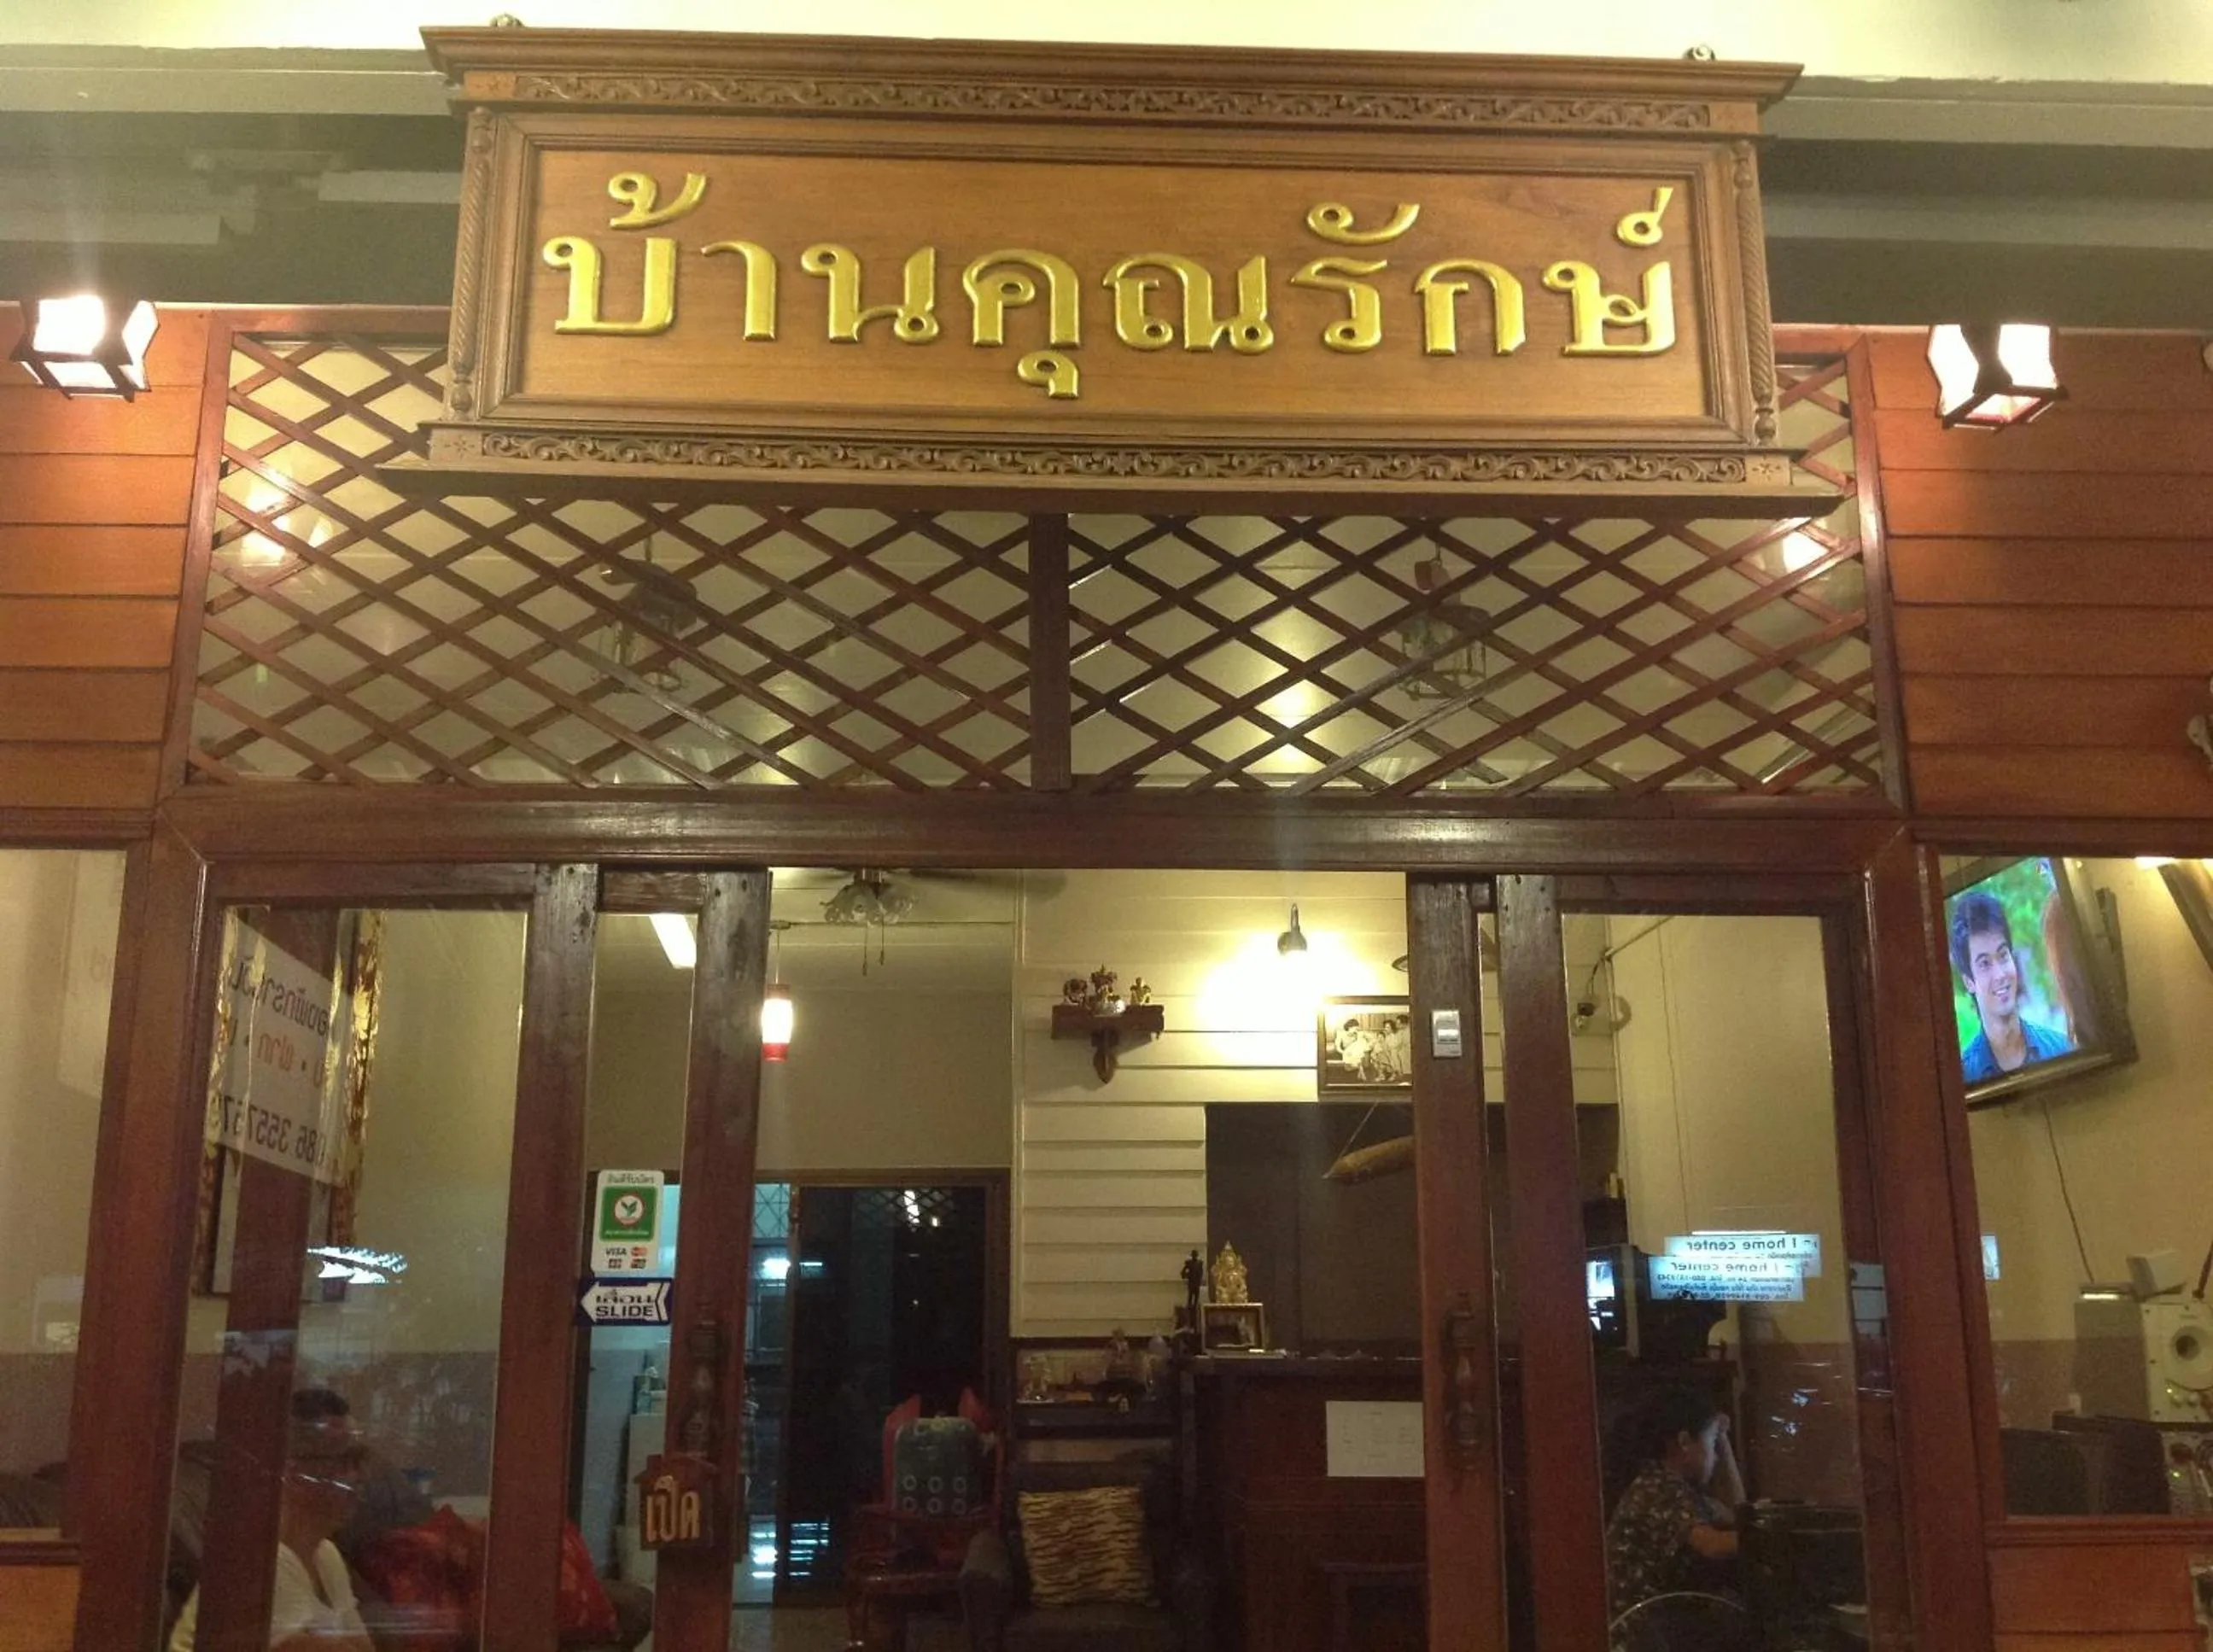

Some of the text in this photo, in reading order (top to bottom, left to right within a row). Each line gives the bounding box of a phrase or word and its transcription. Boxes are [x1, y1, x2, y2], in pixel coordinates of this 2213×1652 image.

[542, 171, 1678, 400] บ้านคุณรักษ์
[596, 1305, 654, 1316] SLIDE
[645, 1474, 701, 1543] เปิด
